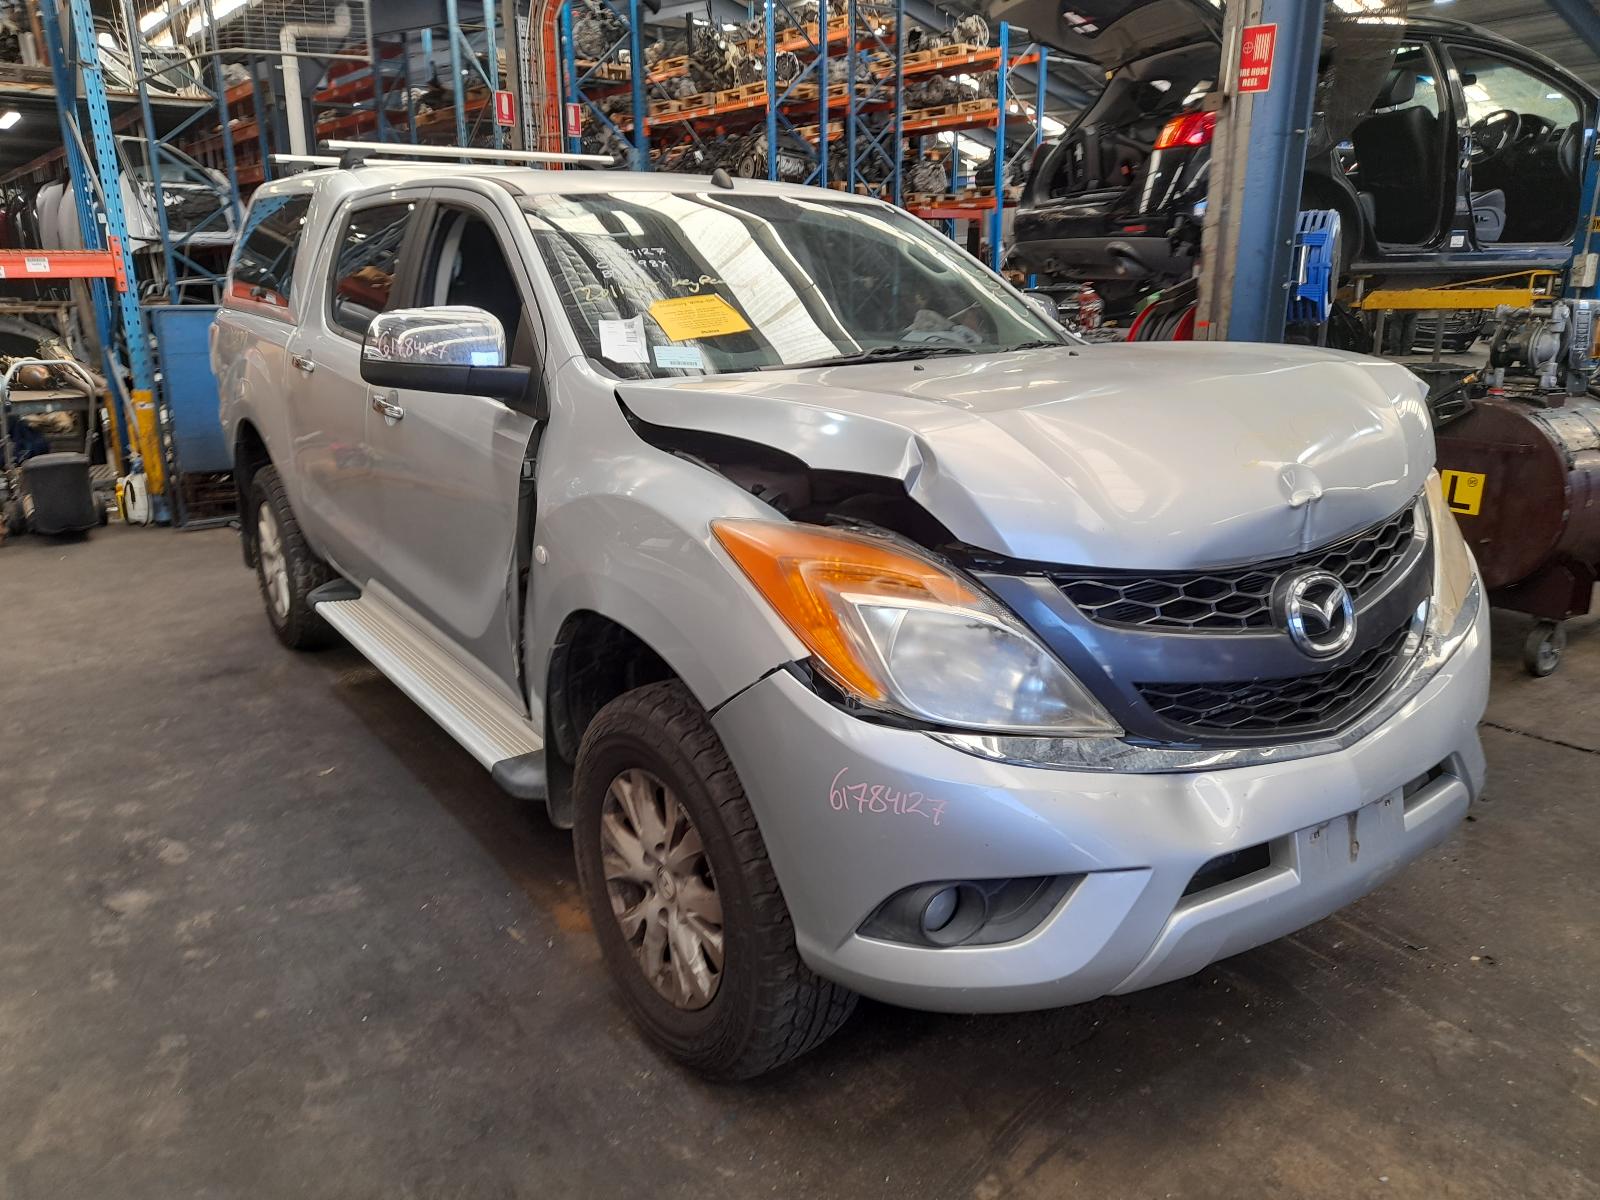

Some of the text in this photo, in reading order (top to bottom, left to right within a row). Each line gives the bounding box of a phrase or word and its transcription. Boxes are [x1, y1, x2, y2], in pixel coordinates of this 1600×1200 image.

[1251, 66, 1268, 76] HOSE
[1242, 79, 1258, 87] REEL
[1448, 475, 1471, 510] L
[829, 767, 950, 826] 61784127
